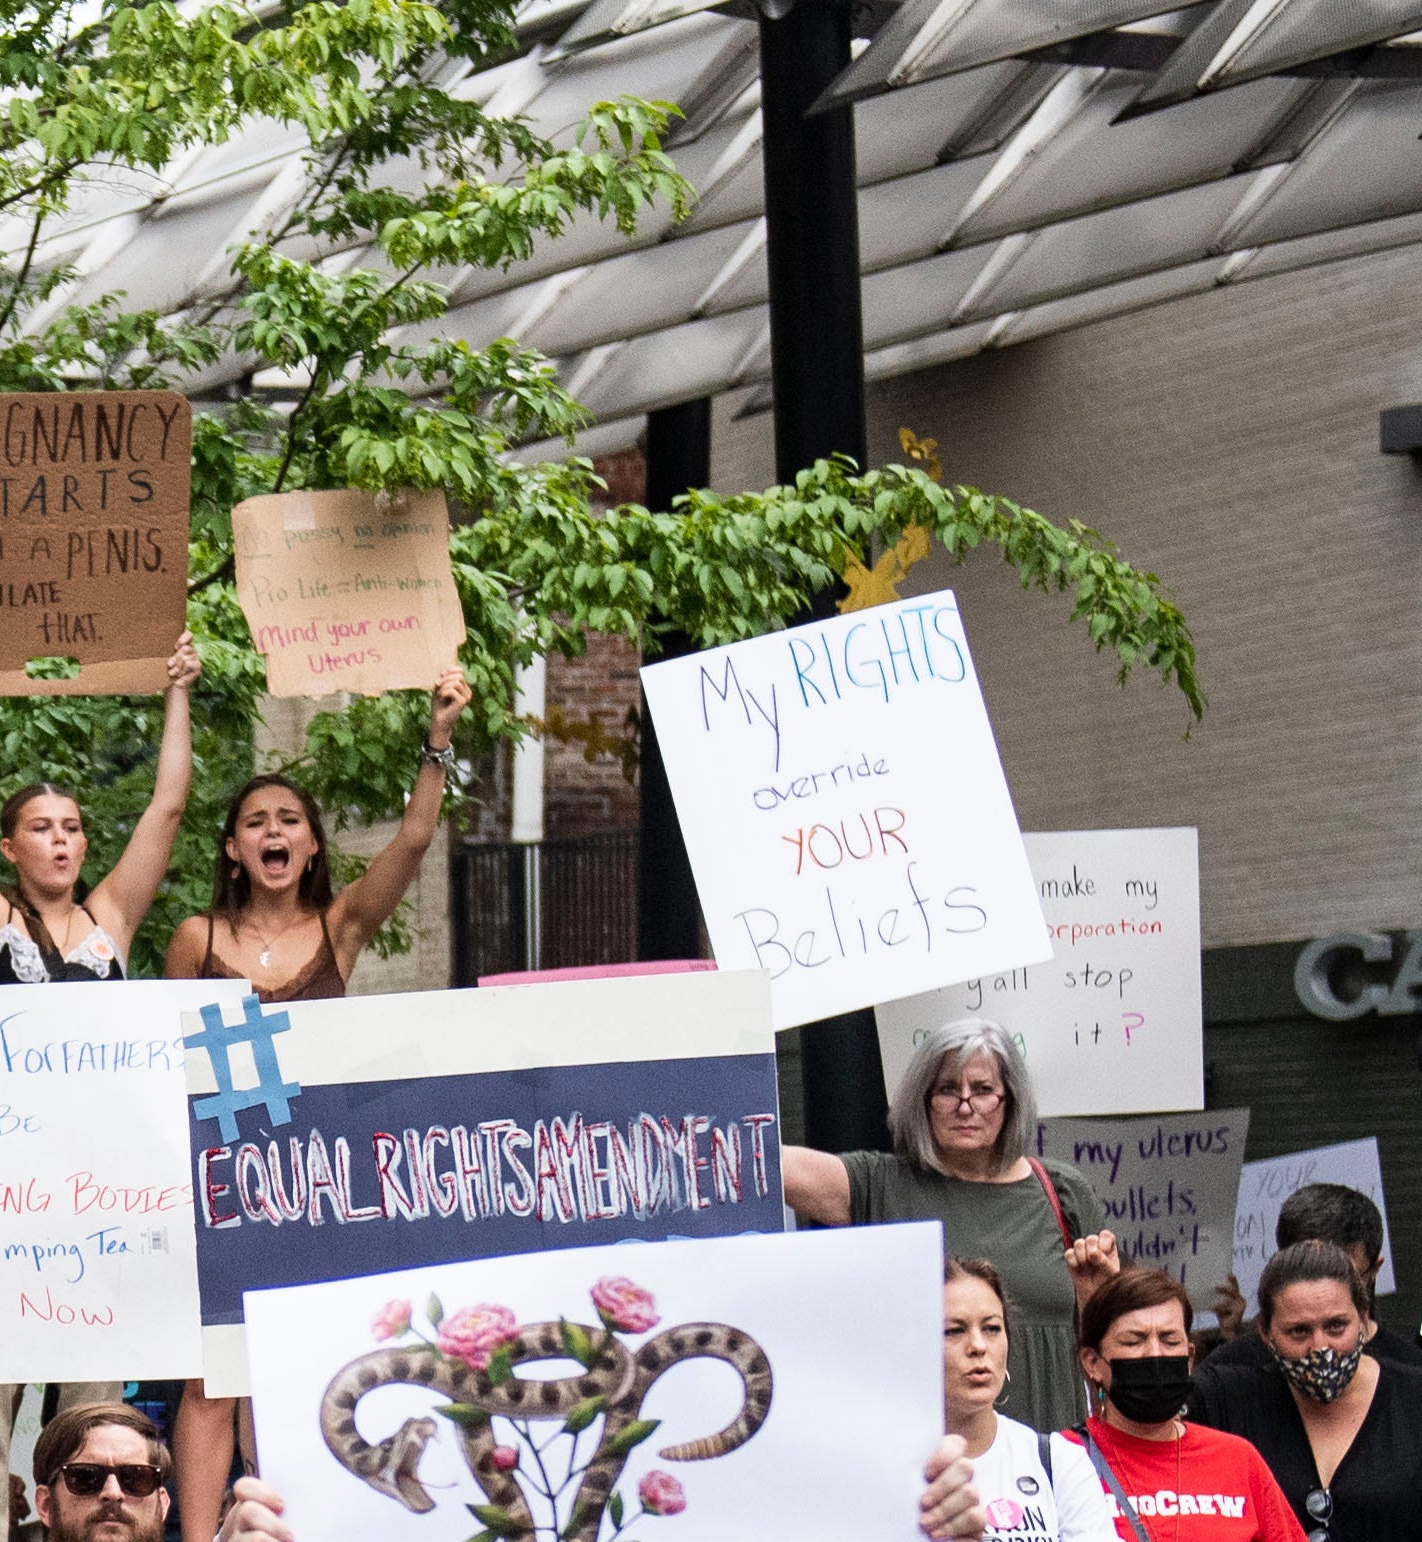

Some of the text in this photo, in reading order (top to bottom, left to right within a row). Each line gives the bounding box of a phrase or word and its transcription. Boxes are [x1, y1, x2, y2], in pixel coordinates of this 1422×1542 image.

[29, 536, 52, 560] A
[67, 528, 168, 580] PENIS.
[258, 614, 421, 650] Mind your own
[308, 648, 383, 675] Uterus
[699, 604, 968, 772] My RIGHTS
[752, 755, 890, 811] override
[782, 806, 909, 876] YOUR
[1041, 864, 1159, 911] make my
[733, 861, 988, 982] Beliefs
[1064, 963, 1134, 999] stop
[1072, 1022, 1103, 1046] it
[198, 1112, 775, 1230] EQUALRIGHTSAMENDMENT
[1074, 1140, 1123, 1184] my
[64, 1170, 194, 1218] BODIES
[87, 1226, 134, 1256] Tea
[20, 1285, 114, 1327] Now
